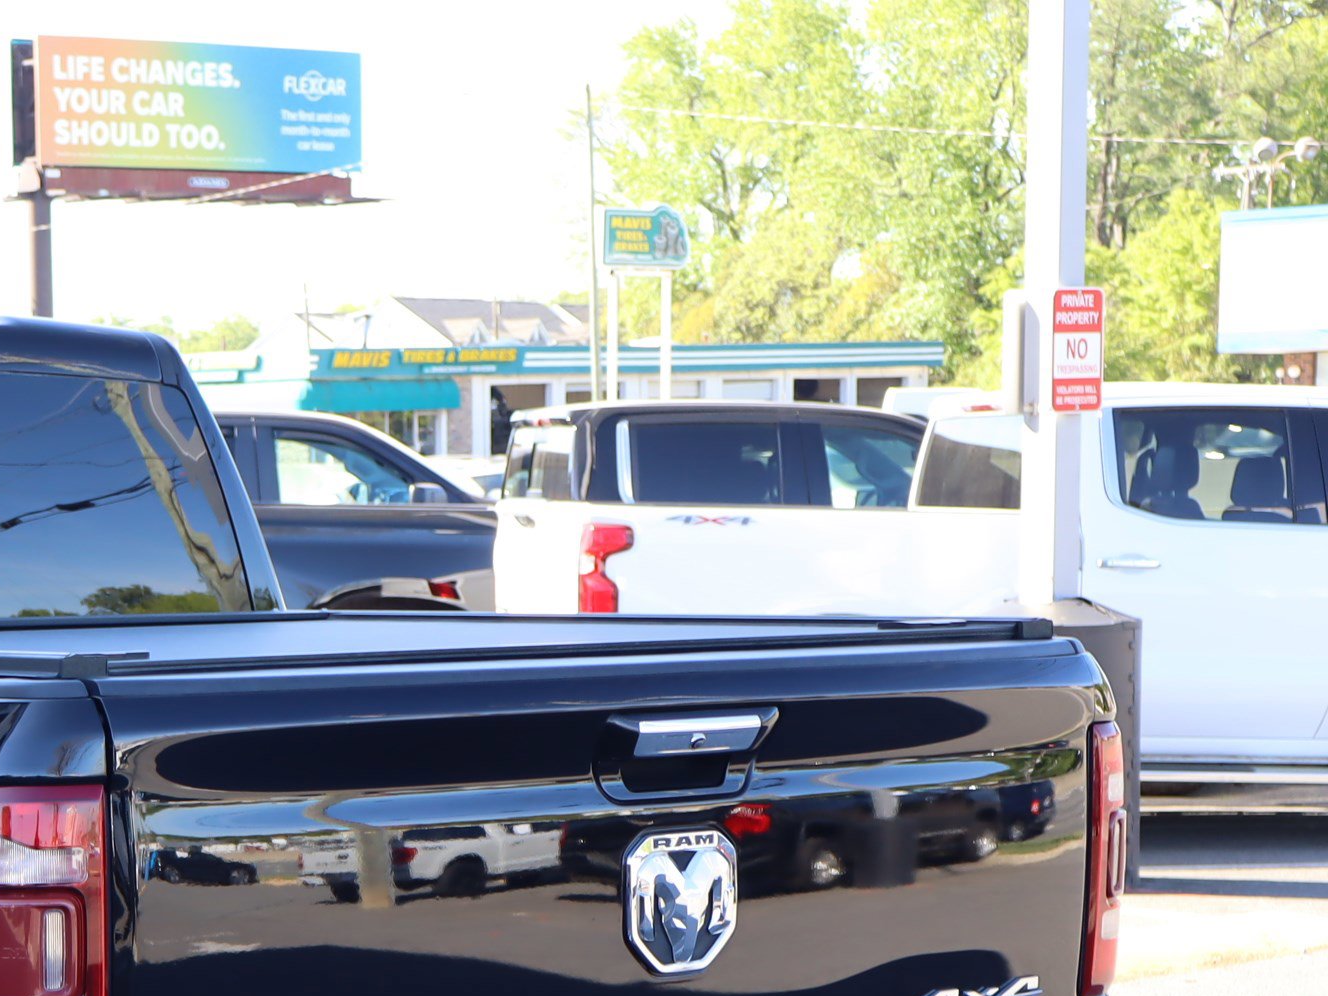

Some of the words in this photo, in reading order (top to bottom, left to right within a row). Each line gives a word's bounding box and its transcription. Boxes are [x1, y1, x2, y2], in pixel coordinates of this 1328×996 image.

[52, 54, 105, 81] LIFE
[111, 57, 241, 89] CHANGES.
[283, 73, 347, 97] FLEXCAR
[53, 86, 127, 114] YOUR
[132, 90, 185, 117] CAR
[54, 119, 161, 147] SHOULD
[166, 123, 226, 150] TOO.
[1061, 294, 1095, 307] PRIVATE
[1056, 311, 1099, 325] PROPERTY
[333, 351, 391, 369] MAVIS
[403, 350, 445, 364] TIRES
[458, 348, 518, 362] BRAKES
[1066, 338, 1088, 360] NO
[652, 833, 715, 850] RAM
